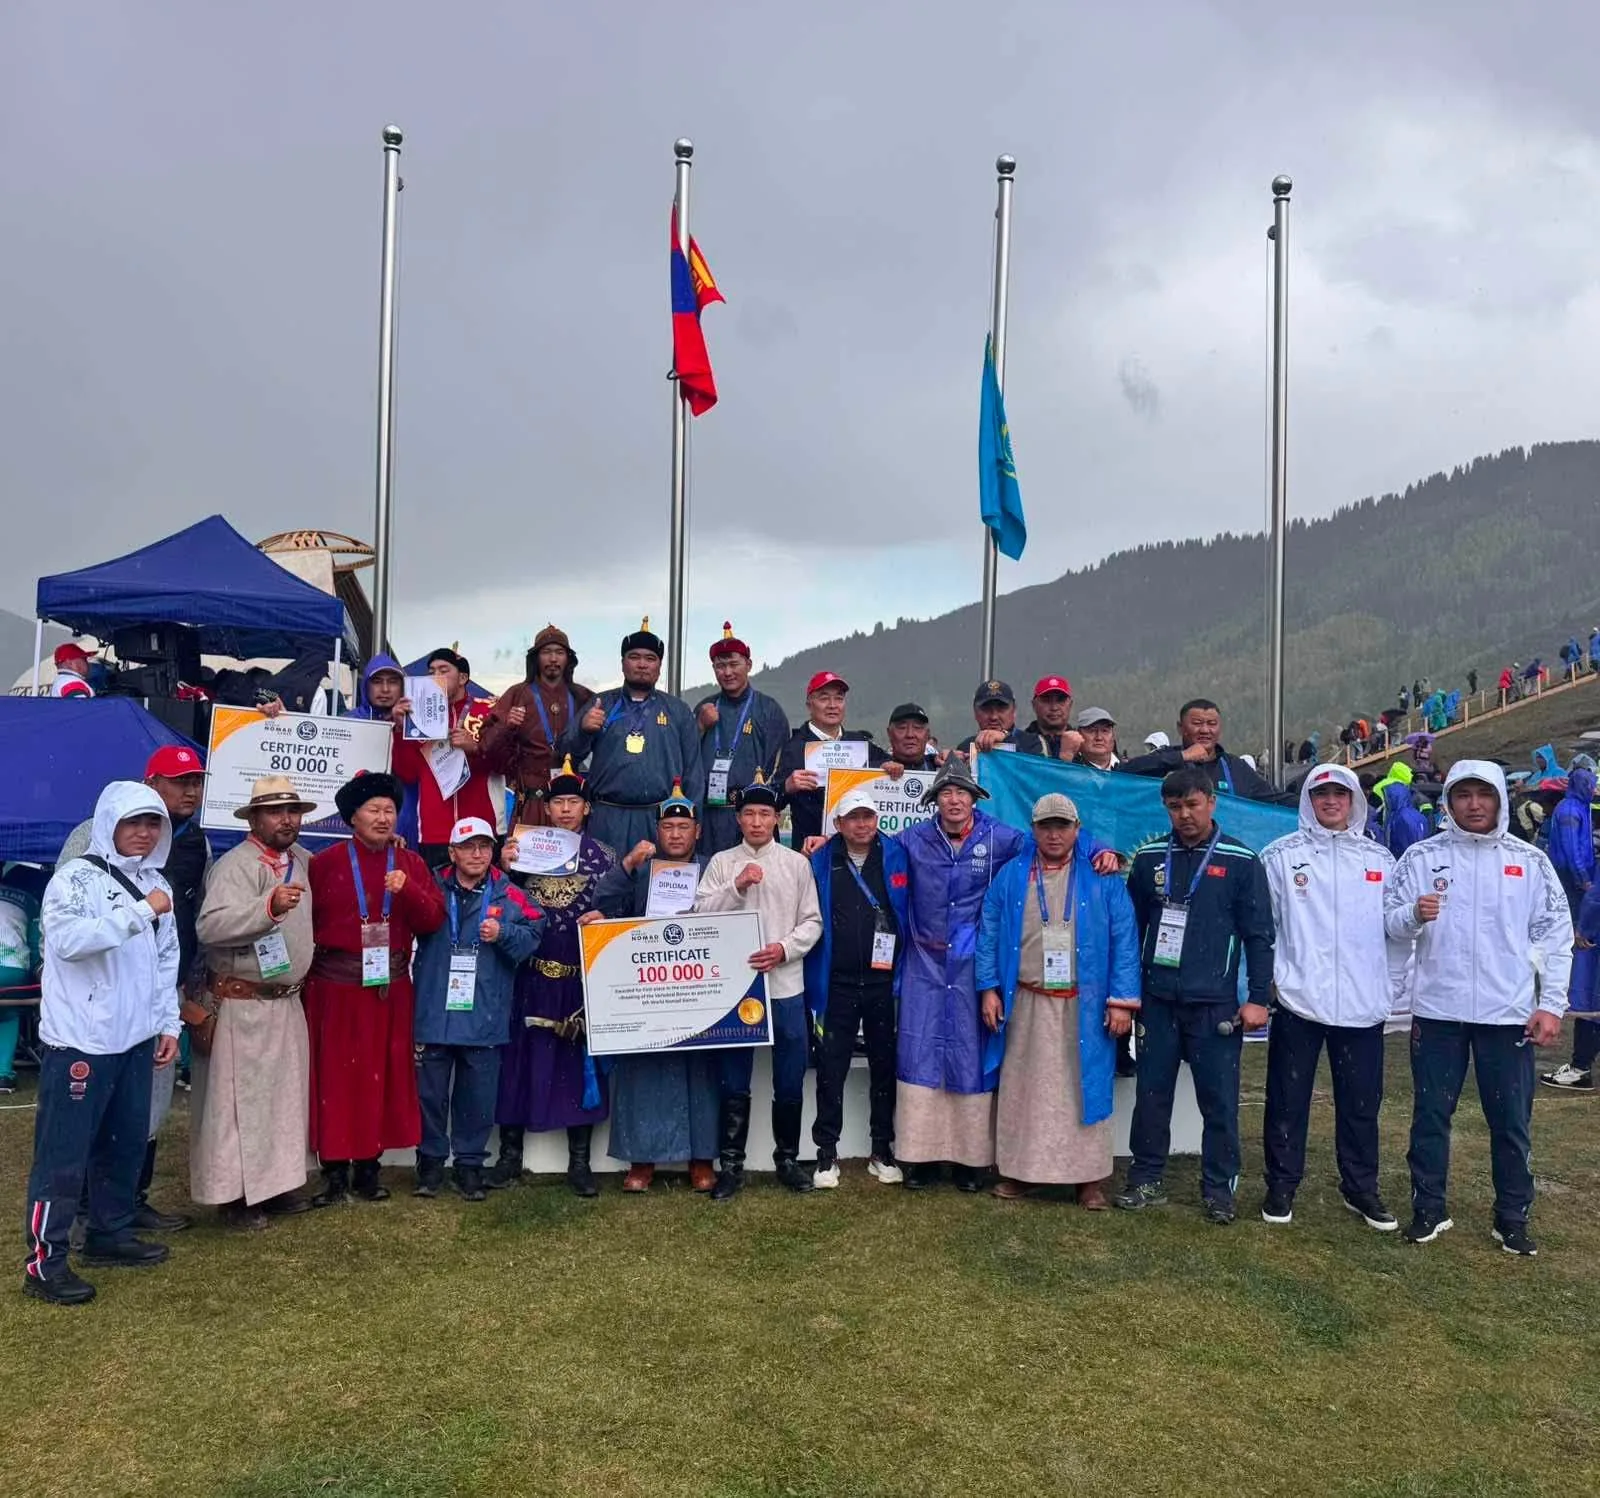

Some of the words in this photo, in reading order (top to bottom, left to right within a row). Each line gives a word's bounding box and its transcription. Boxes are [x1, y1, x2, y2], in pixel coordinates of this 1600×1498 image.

[260, 740, 340, 759] CERTIFICATE
[270, 755, 292, 771] 80
[296, 757, 328, 774] 000
[873, 800, 937, 814] ERTIFICAT
[879, 815, 898, 831] 60
[658, 881, 689, 890] DIPLOMA
[631, 934, 659, 942] NOMAD
[631, 948, 711, 964] CERTIFICATE
[637, 966, 668, 983] 100
[672, 964, 704, 981] 000
